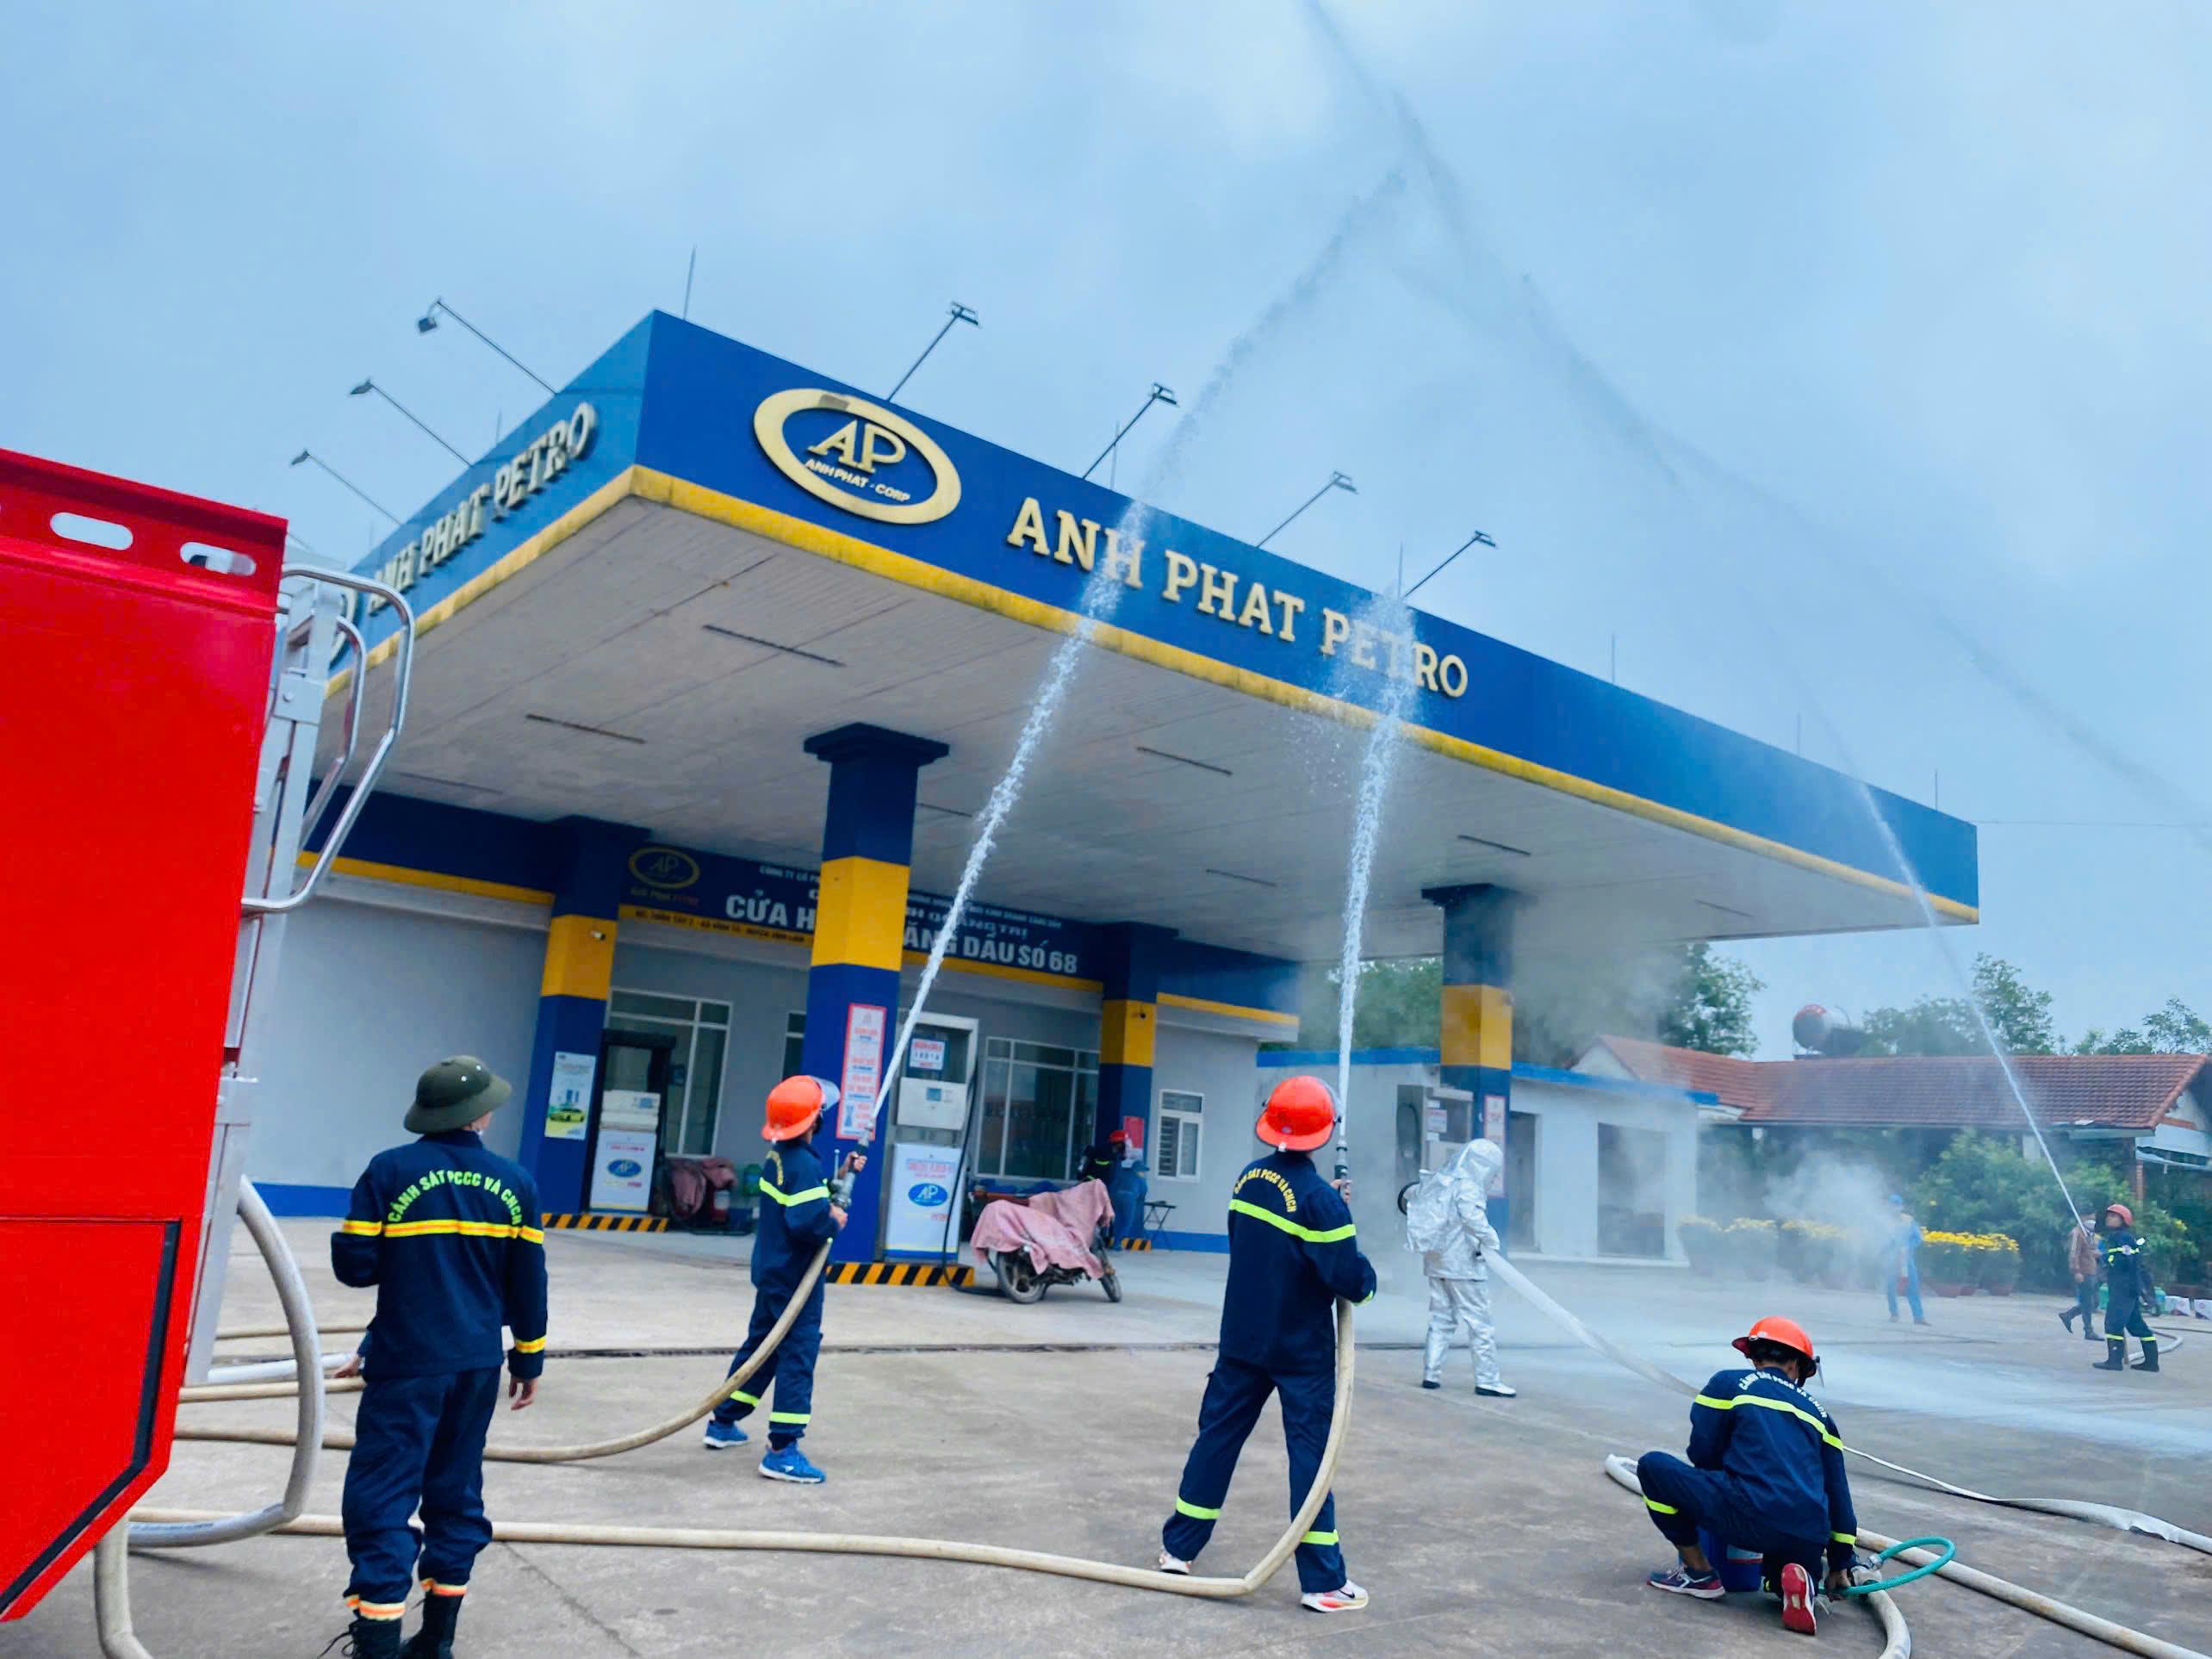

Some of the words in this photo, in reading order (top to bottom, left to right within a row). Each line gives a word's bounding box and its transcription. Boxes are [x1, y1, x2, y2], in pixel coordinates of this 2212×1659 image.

[807, 419, 906, 473] AP
[419, 482, 491, 575] PHAT
[493, 401, 597, 521] PETRO
[805, 458, 835, 477] ANH
[833, 466, 869, 488] PHAT
[874, 482, 910, 502] CORP
[1007, 497, 1145, 588] ANH
[1161, 550, 1305, 643] PHAT
[1320, 606, 1469, 699] PETRO
[725, 889, 788, 928] CỬA
[1048, 950, 1078, 974] 68
[446, 1170, 482, 1187] PCCC
[500, 1188, 523, 1226] CNCH
